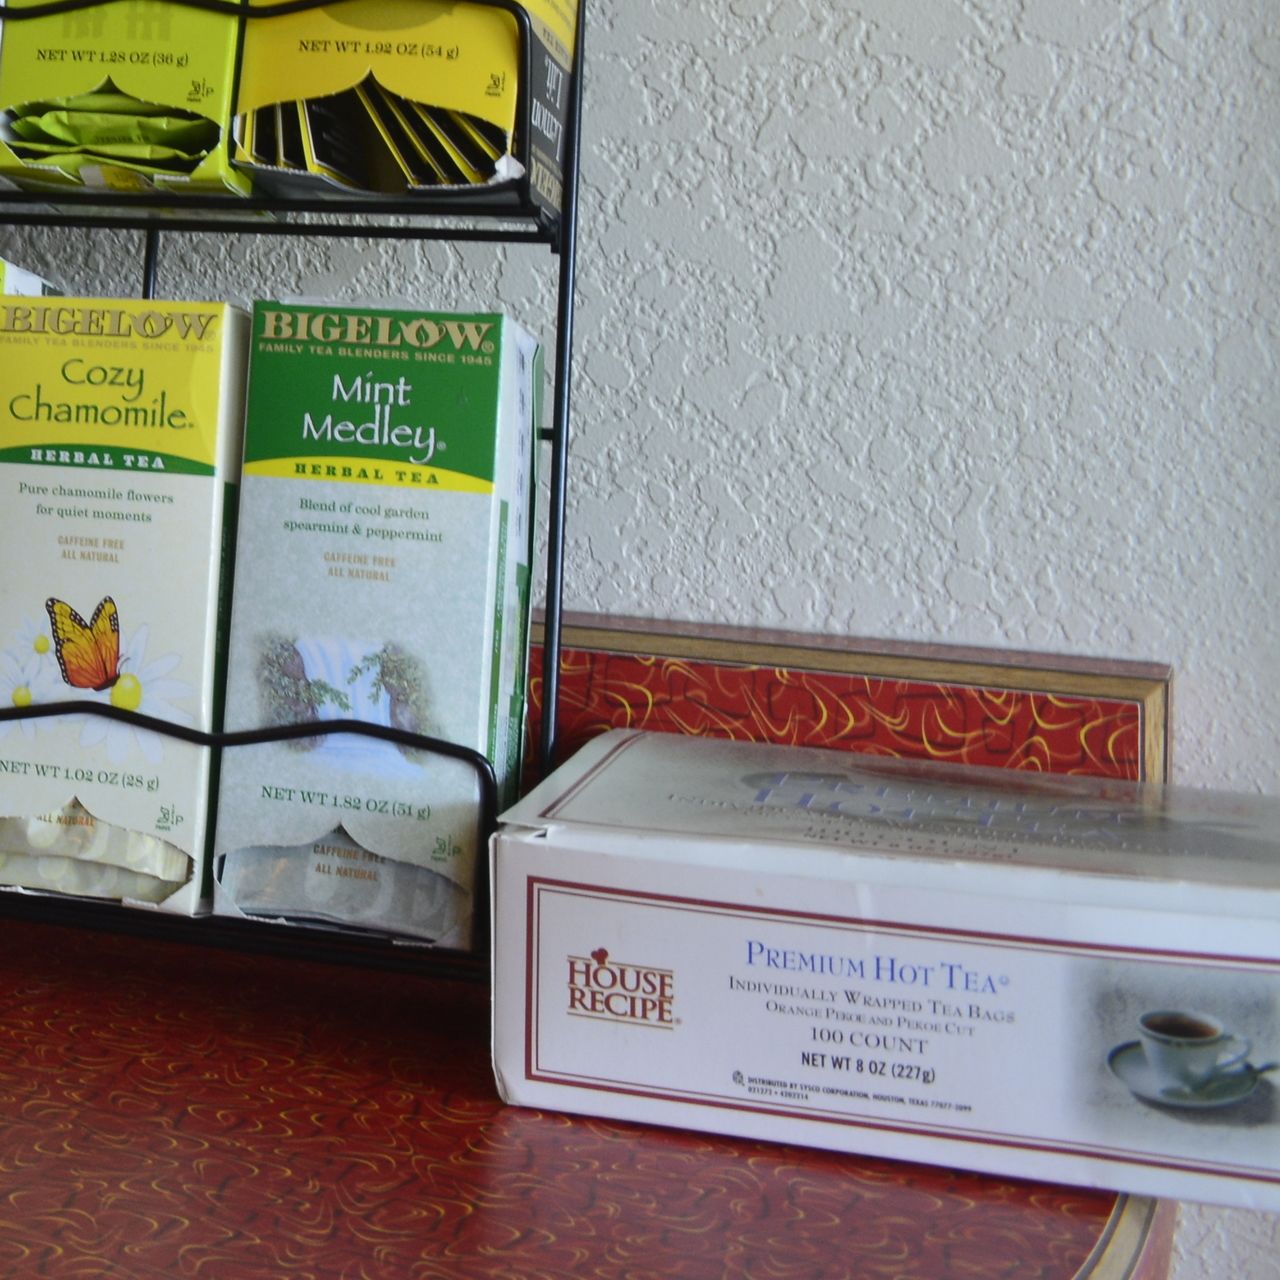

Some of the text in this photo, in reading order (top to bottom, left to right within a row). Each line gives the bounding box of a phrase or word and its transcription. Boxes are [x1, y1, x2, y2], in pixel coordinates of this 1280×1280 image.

[259, 342, 492, 366] FAMILY TEA BLENDERS SINCE 1945
[61, 358, 144, 402] Cozy
[332, 371, 412, 407] Mint
[9, 384, 185, 429] Chamomile
[302, 404, 435, 465] Medley
[31, 448, 165, 469] HERBAL TEA
[295, 464, 439, 484] HERBAL TEA
[19, 482, 174, 504] Pure chamomile flowers
[36, 504, 152, 522] for quiet moments
[300, 498, 429, 520] Blend of cool garden
[58, 535, 124, 550] CAFFEINE FREE
[283, 520, 443, 543] spearmint & peppermint
[61, 550, 119, 563] ALL NATURAL
[0, 760, 30, 775] NET
[34, 765, 60, 778] WT
[64, 768, 93, 782] 1.02
[98, 771, 119, 785] OZ
[261, 786, 295, 801] NET
[300, 792, 328, 806] WT
[332, 796, 361, 810] 1.82
[366, 799, 389, 813] OZ
[746, 940, 865, 979] PREMIUM
[874, 956, 935, 987] HOT
[568, 959, 673, 1000] HOUSE
[568, 986, 673, 1023] RECIPE
[729, 976, 1015, 1023] INDIVIDUALLY WRAPPED TEA BAGS
[766, 1000, 976, 1037] ORANGE PEKOE AND PEKOE CUT
[811, 1027, 929, 1055] 100 COUNT
[802, 1052, 936, 1084] NET WT 8 OZ (227g)
